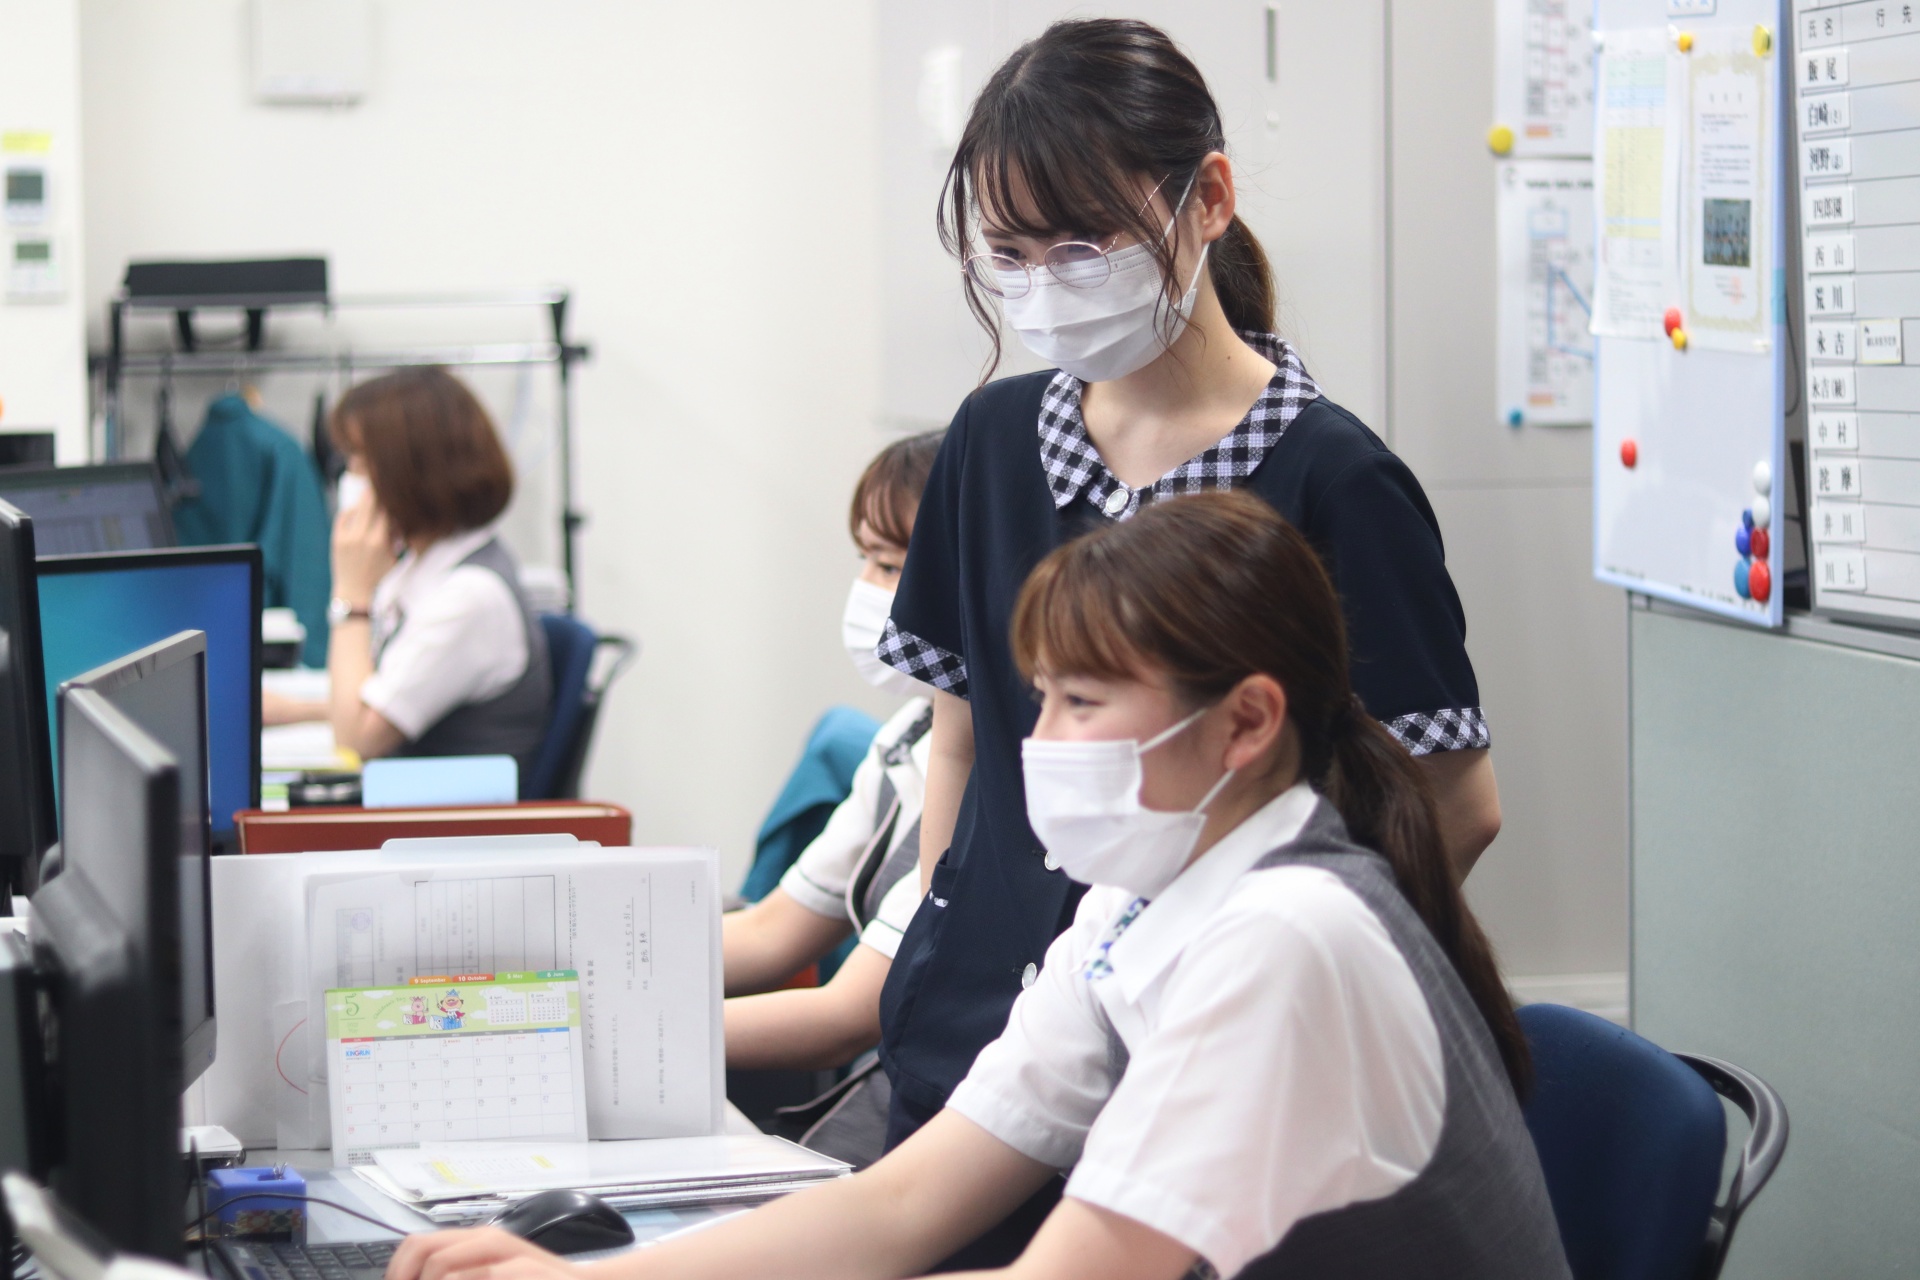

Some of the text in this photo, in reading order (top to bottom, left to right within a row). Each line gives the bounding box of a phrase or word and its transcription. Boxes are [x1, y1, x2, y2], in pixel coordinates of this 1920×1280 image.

[1817, 330, 1844, 355] 永吉
[1818, 421, 1846, 443] 中村
[1826, 561, 1855, 584] 川上
[345, 993, 359, 1016] 5
